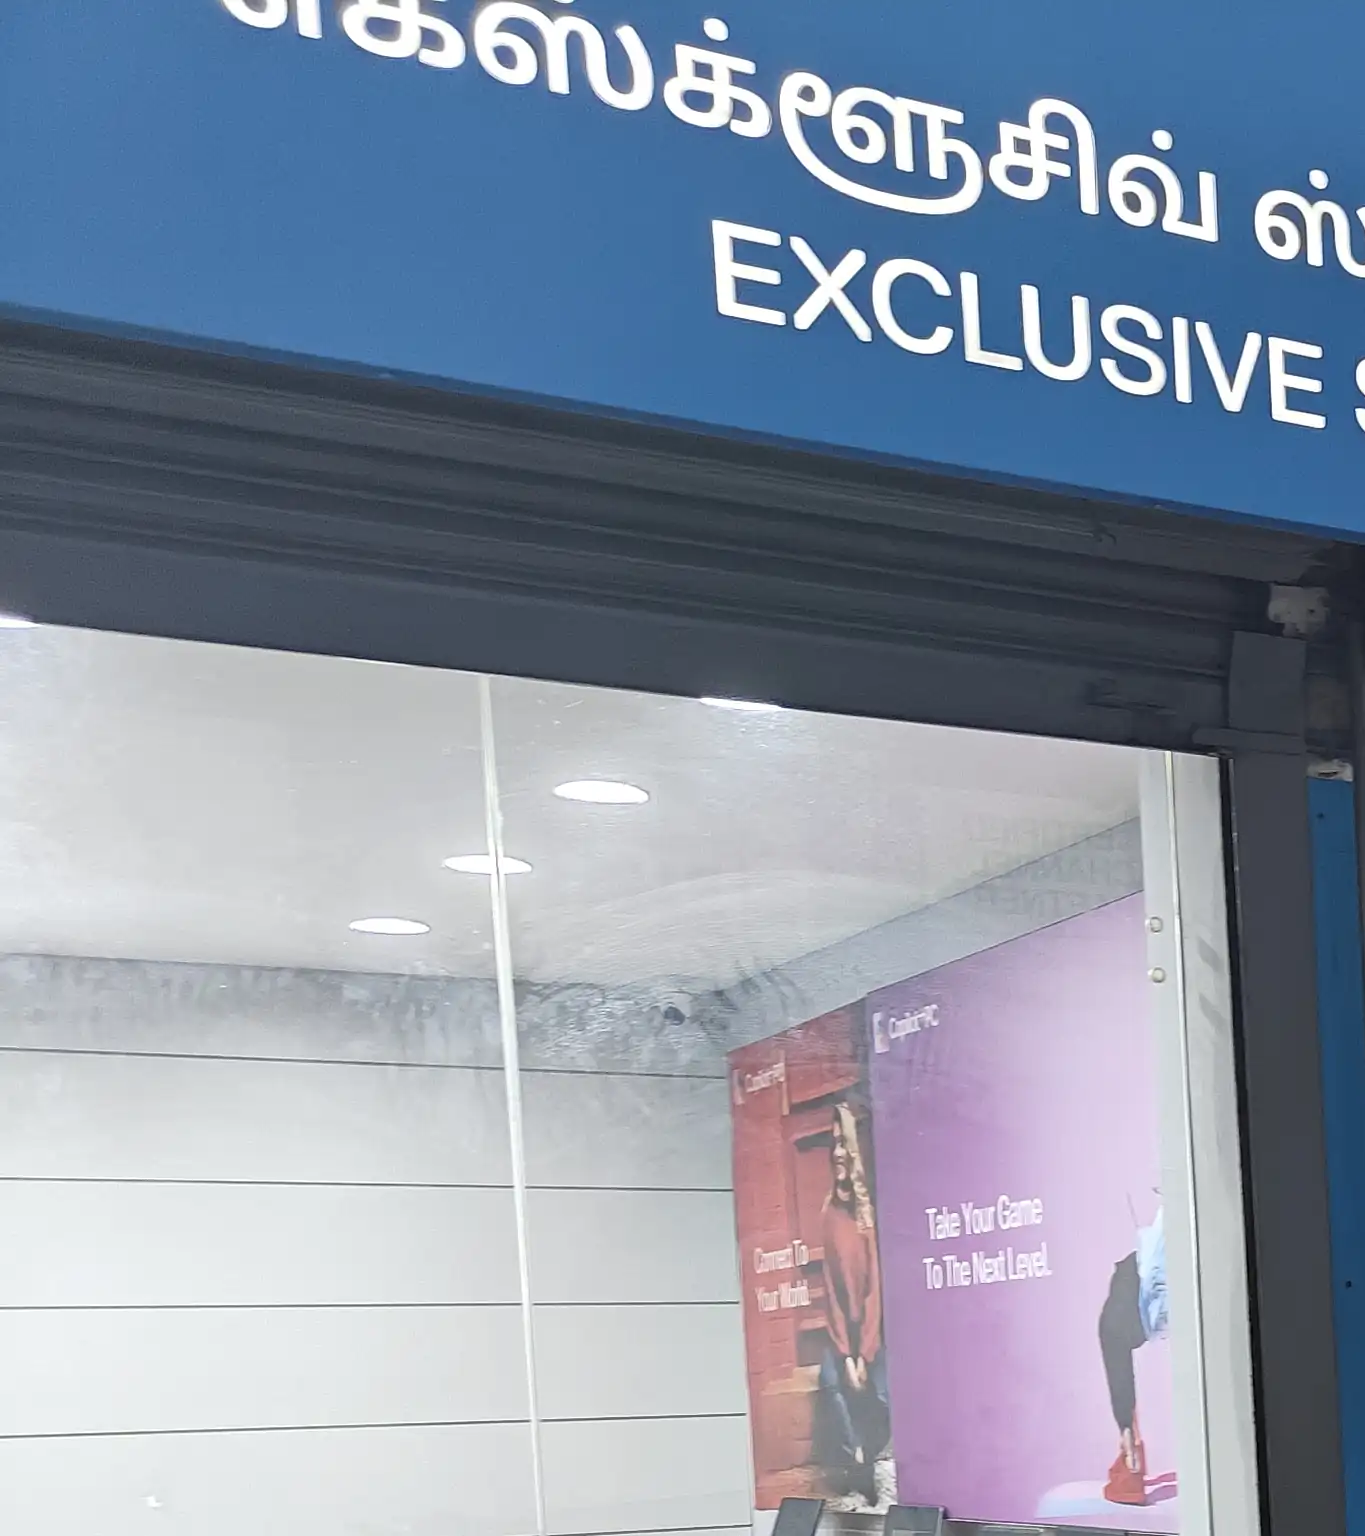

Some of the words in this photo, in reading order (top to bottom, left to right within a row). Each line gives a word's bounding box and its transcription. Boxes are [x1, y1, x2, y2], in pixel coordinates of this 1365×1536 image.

[712, 219, 1326, 431] EXCLUSIVE
[925, 1207, 961, 1240] Take
[961, 1202, 996, 1236] Your
[998, 1194, 1043, 1231] Game
[923, 1257, 943, 1290] To
[942, 1254, 972, 1288] The
[972, 1249, 1006, 1284] Next
